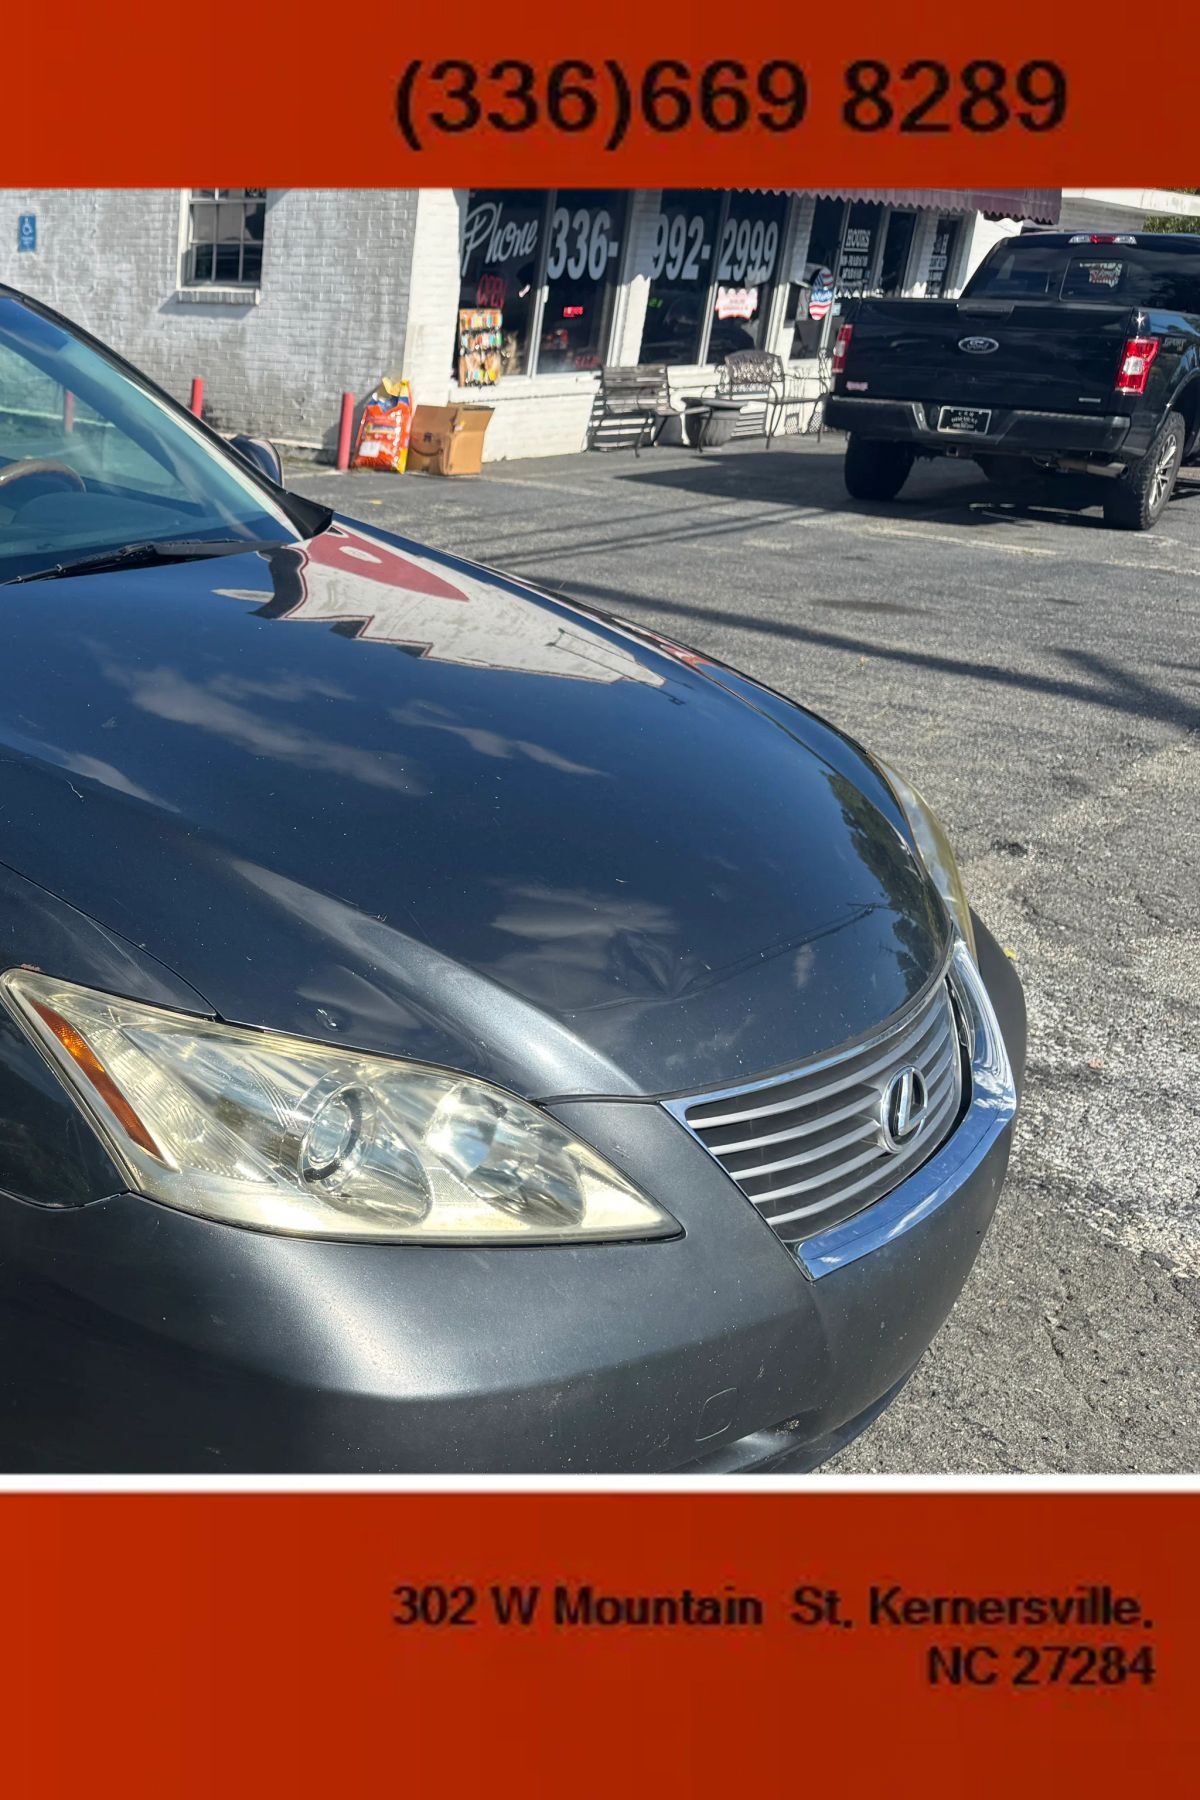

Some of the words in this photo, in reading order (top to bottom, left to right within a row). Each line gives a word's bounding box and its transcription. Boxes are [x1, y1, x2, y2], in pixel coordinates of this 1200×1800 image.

[461, 202, 538, 277] Phone
[547, 207, 618, 280] 336-
[650, 214, 711, 280] 992-
[717, 218, 778, 283] 2999
